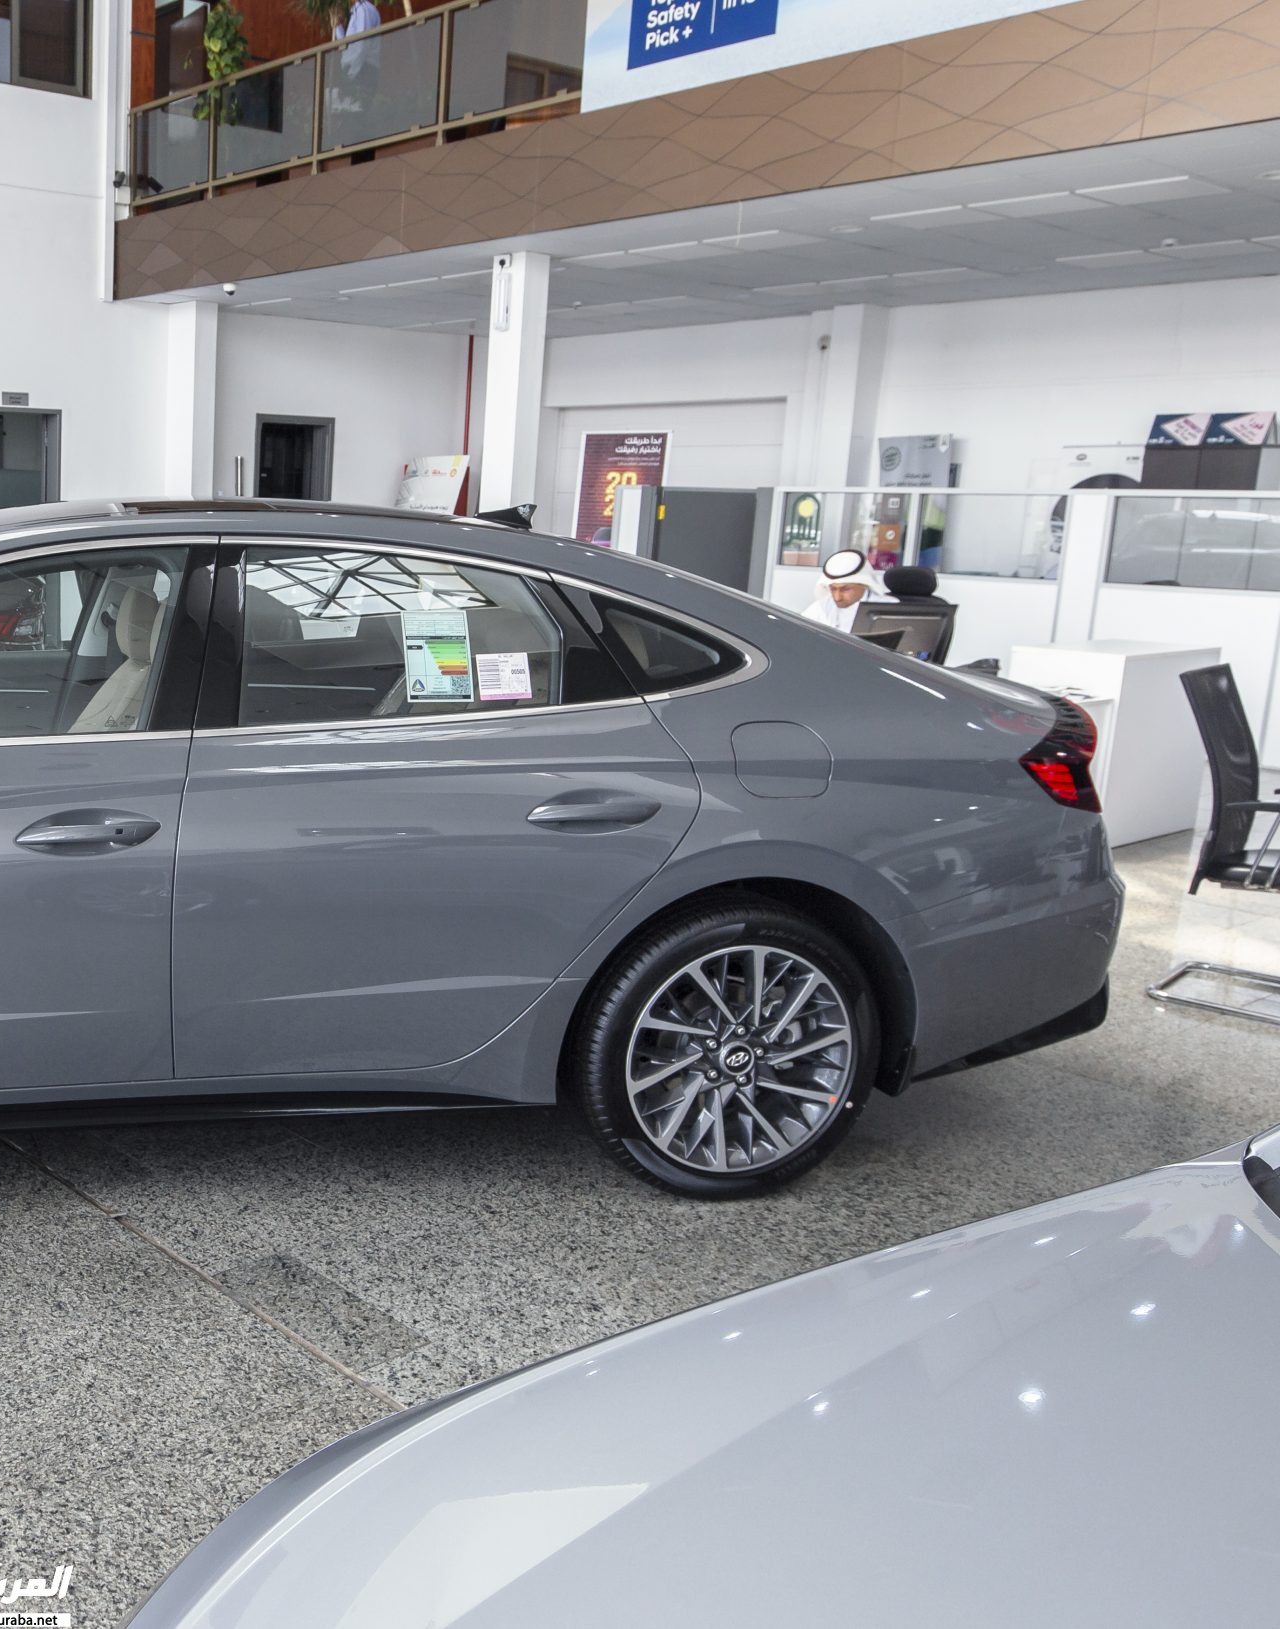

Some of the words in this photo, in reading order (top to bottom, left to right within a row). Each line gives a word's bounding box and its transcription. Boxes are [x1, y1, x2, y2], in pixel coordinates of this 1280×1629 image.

[646, 1, 701, 29] Safety
[645, 26, 680, 50] Pick
[682, 25, 693, 39] +
